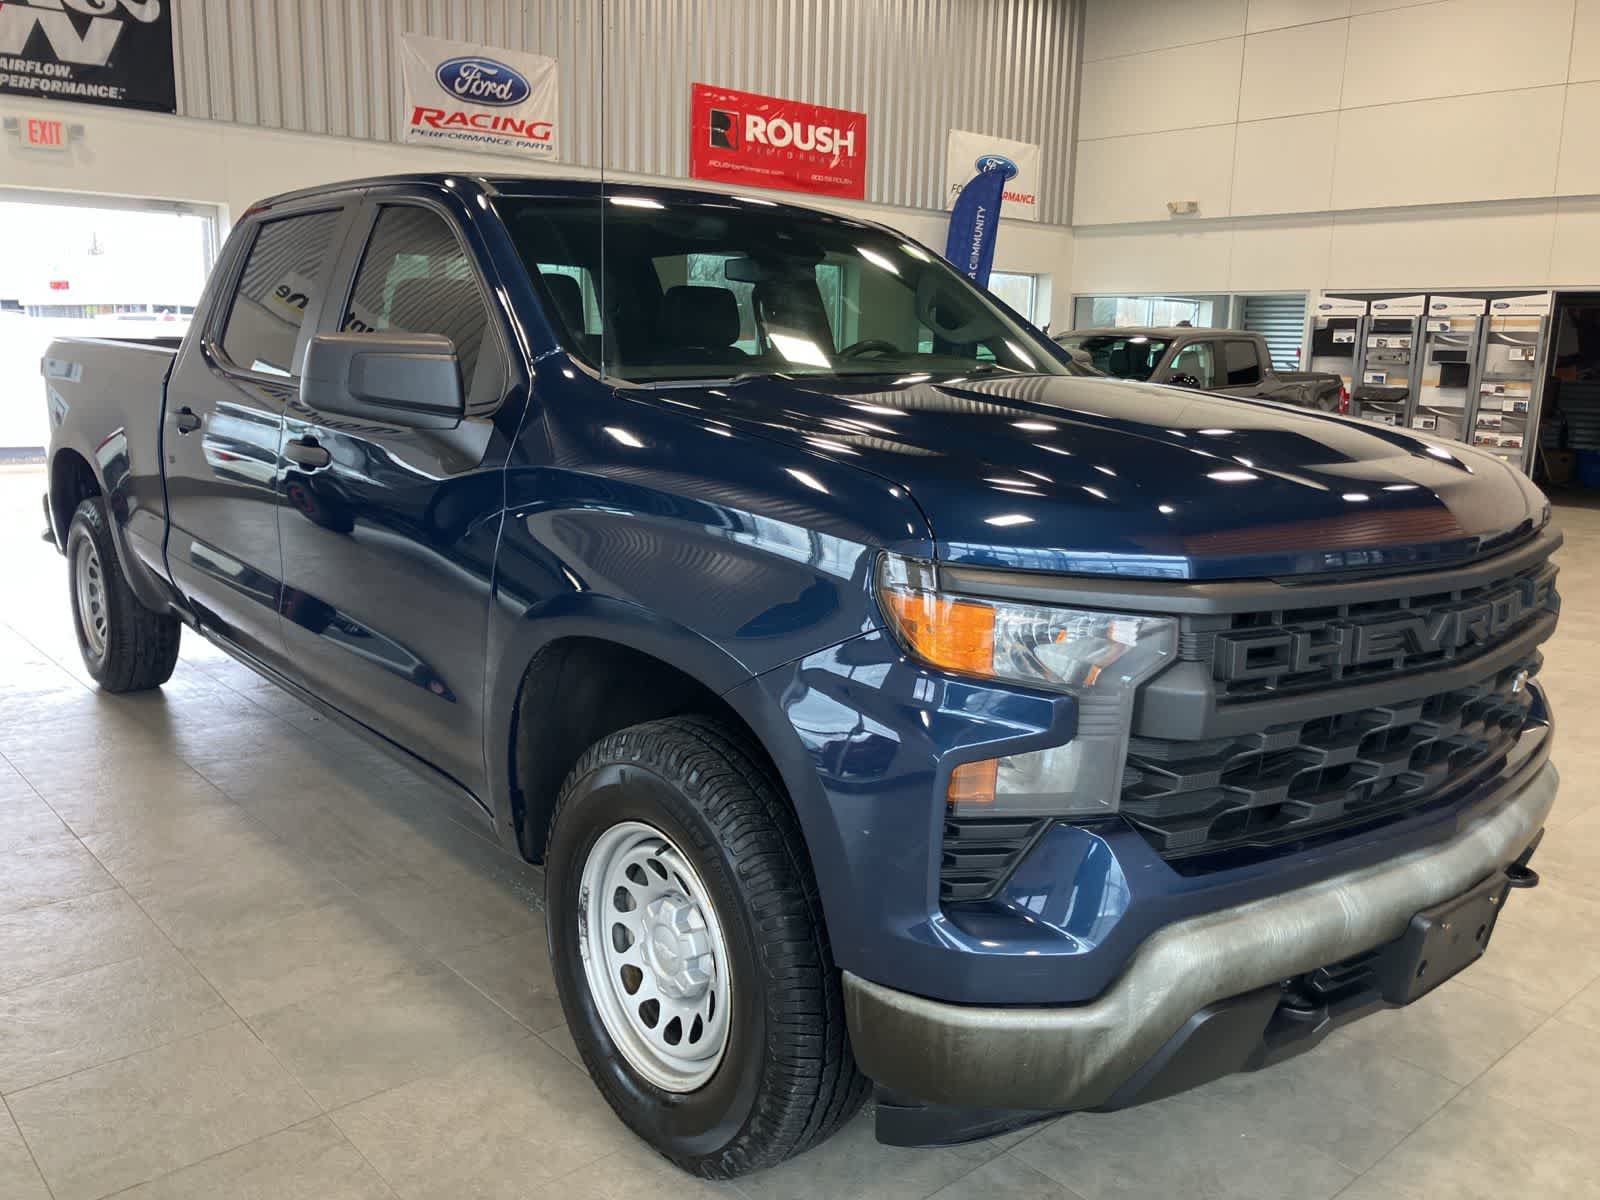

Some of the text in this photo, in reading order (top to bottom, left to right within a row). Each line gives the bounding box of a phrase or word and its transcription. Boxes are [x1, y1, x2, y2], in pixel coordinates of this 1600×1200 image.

[454, 62, 513, 101] Ford
[28, 117, 62, 145] EXIT
[410, 127, 553, 151] PERFORMANCE PARTS
[411, 106, 553, 141] RACING
[745, 113, 855, 158] ROUSH
